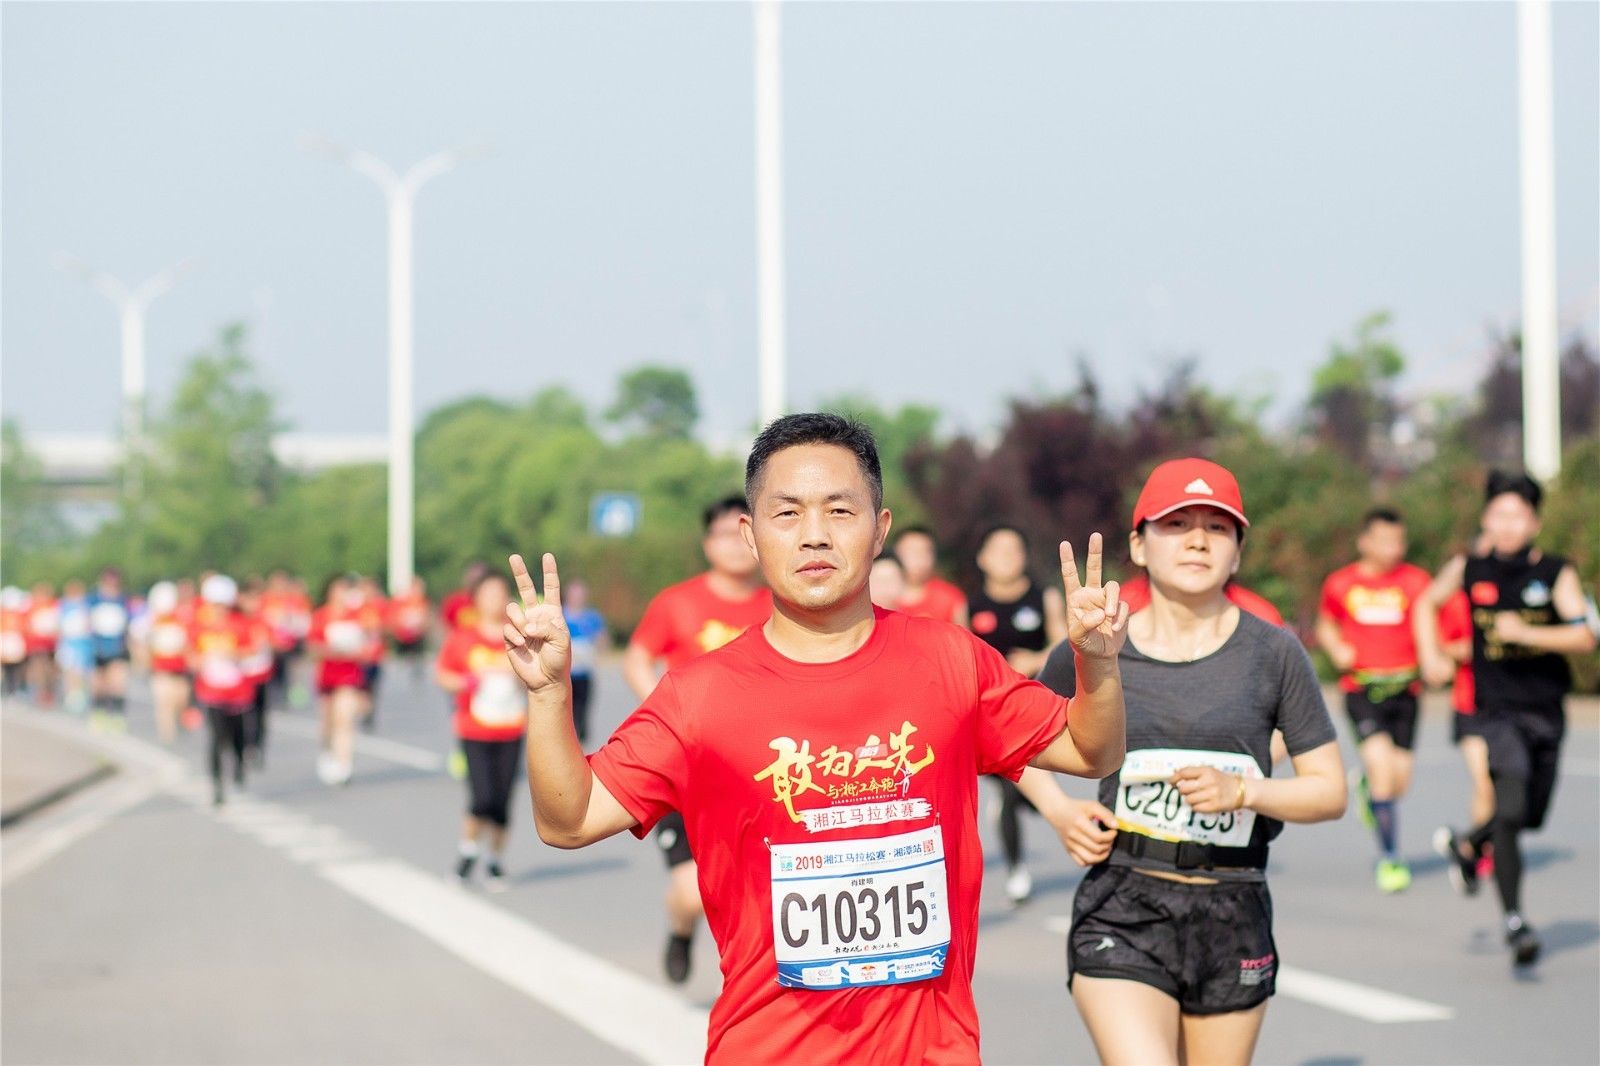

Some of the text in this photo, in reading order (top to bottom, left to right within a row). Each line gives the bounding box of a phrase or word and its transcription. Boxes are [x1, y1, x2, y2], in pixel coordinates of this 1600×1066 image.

[813, 803, 915, 828] 湘江马拉松赛
[781, 881, 928, 948] C10315
